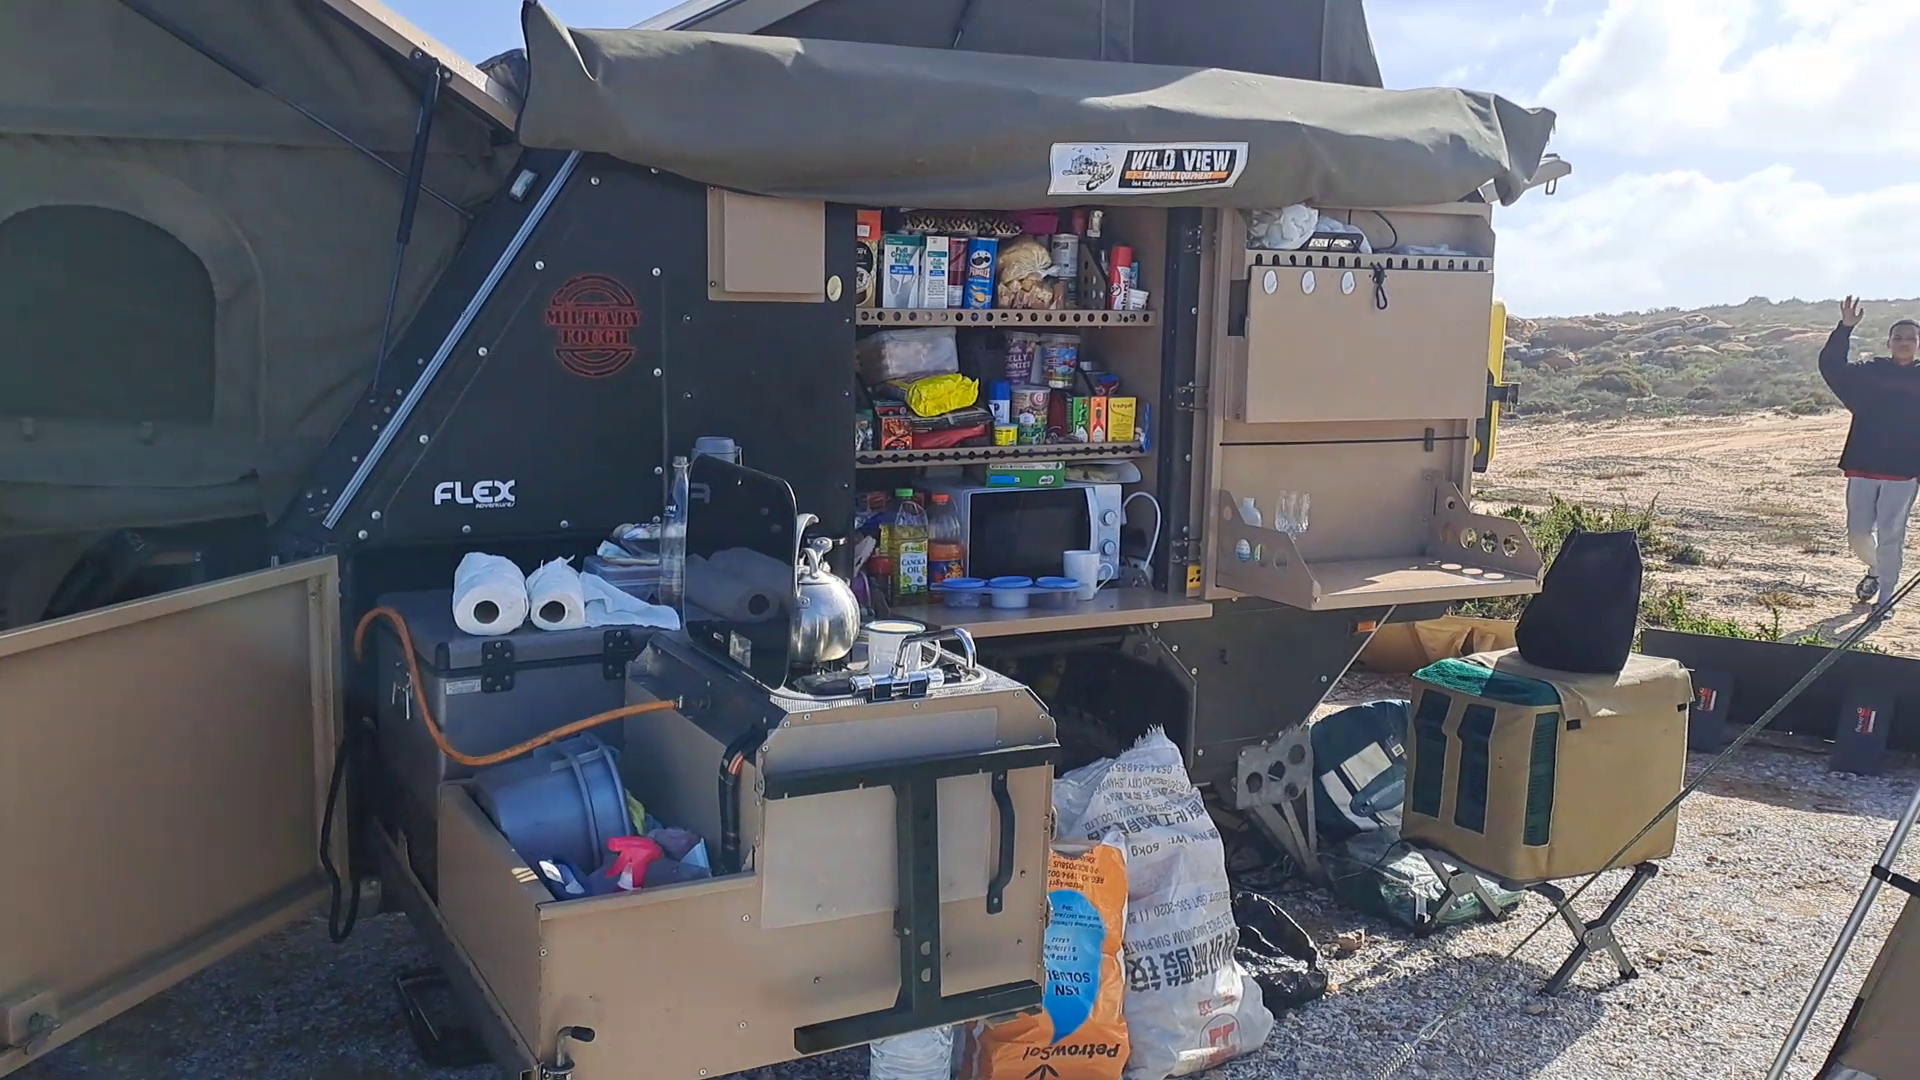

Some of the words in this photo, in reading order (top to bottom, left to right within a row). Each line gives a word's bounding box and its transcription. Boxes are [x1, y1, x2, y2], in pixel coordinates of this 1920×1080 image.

[1131, 150, 1175, 171] WILD
[1183, 149, 1231, 171] VIEW
[1143, 171, 1175, 180] CAMPING
[1176, 170, 1214, 181] EQUIPMENT
[546, 308, 640, 327] MILITARY
[558, 329, 630, 345] TOUGH
[434, 480, 516, 505] FLEX
[902, 558, 926, 566] CANOLA
[906, 566, 920, 574] OIL
[1131, 843, 1160, 858] 50kg
[1055, 984, 1080, 997] ASN
[1022, 1043, 1121, 1061] PetrowSol
